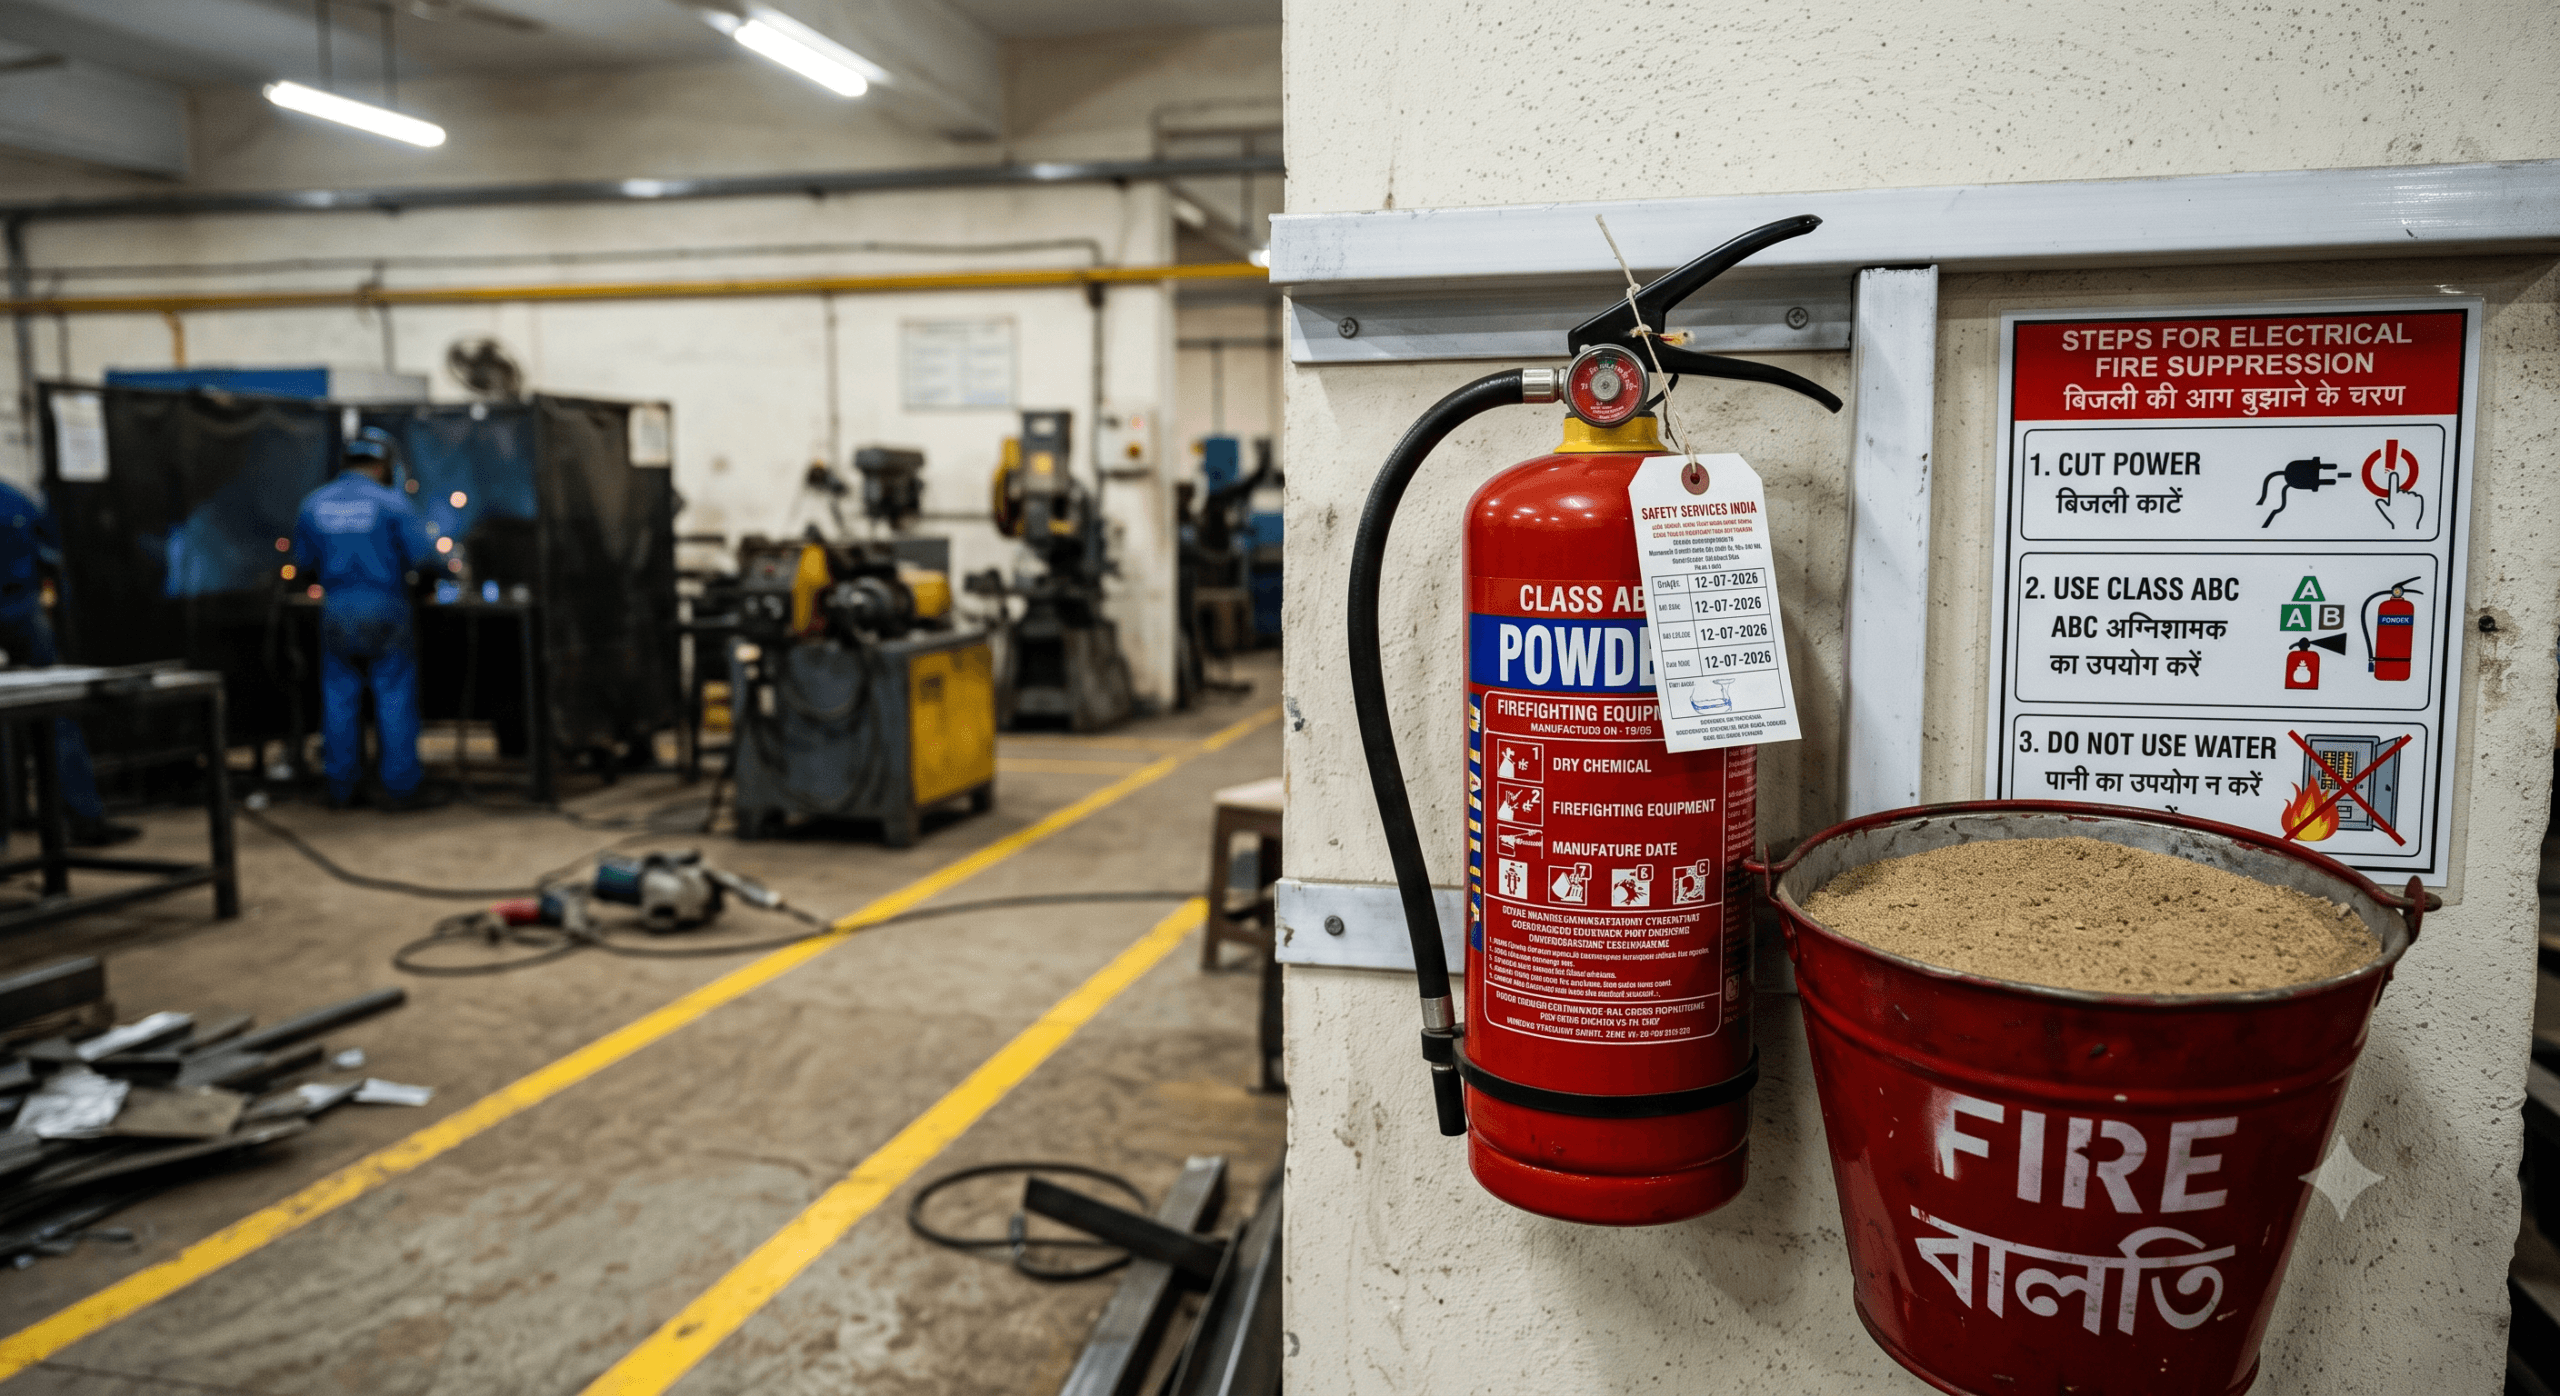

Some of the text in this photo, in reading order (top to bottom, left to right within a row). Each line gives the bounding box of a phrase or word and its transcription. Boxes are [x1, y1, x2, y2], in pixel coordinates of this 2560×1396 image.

[2062, 323, 2413, 351] STEPS FOR ELECTRICAL
[2096, 352, 2374, 378] FIRE SUPPRESSION
[2063, 379, 2406, 416] बिजली की आग बुझाने के चरण
[2030, 452, 2201, 477] 1. CUT POWER
[1641, 501, 1757, 520] SAFETY SERVICES INDIA
[2056, 486, 2183, 514] बिजली काटें
[1695, 572, 1758, 588] 12-07-2026
[2025, 576, 2240, 601] 2. USE CLASS ABC
[2299, 580, 2319, 600] A
[1519, 584, 1646, 613] CLASS AB
[1695, 596, 1762, 613] 12-07-2026
[2051, 611, 2228, 640] ABC अग्निशामक
[2286, 607, 2306, 628] A
[2323, 607, 2341, 627] B
[1700, 623, 1767, 641] 12-07-2026
[1500, 622, 1656, 687] POWDE
[1705, 650, 1772, 669] 12-07-2026
[2050, 648, 2202, 677] का उपयोग करें
[1497, 699, 1662, 723] FIREFIGHTING EQUIP
[1603, 726, 1617, 736] ON
[1532, 747, 1539, 760] 1
[2019, 730, 2277, 760] 3. DO NOT USE WATER
[1553, 757, 1652, 774] DRY CHEMICAL
[2045, 765, 2263, 797] पानी का उपयोग न करें
[1531, 790, 1541, 804] 2
[1552, 801, 1643, 817] FIREFIGHTING
[1647, 798, 1716, 818] EQUIPMENT
[1552, 841, 1642, 857] MANUFATURE
[1646, 842, 1678, 857] DATE
[1932, 1087, 2239, 1214] FIRE
[1910, 1204, 2236, 1336] বালতি
